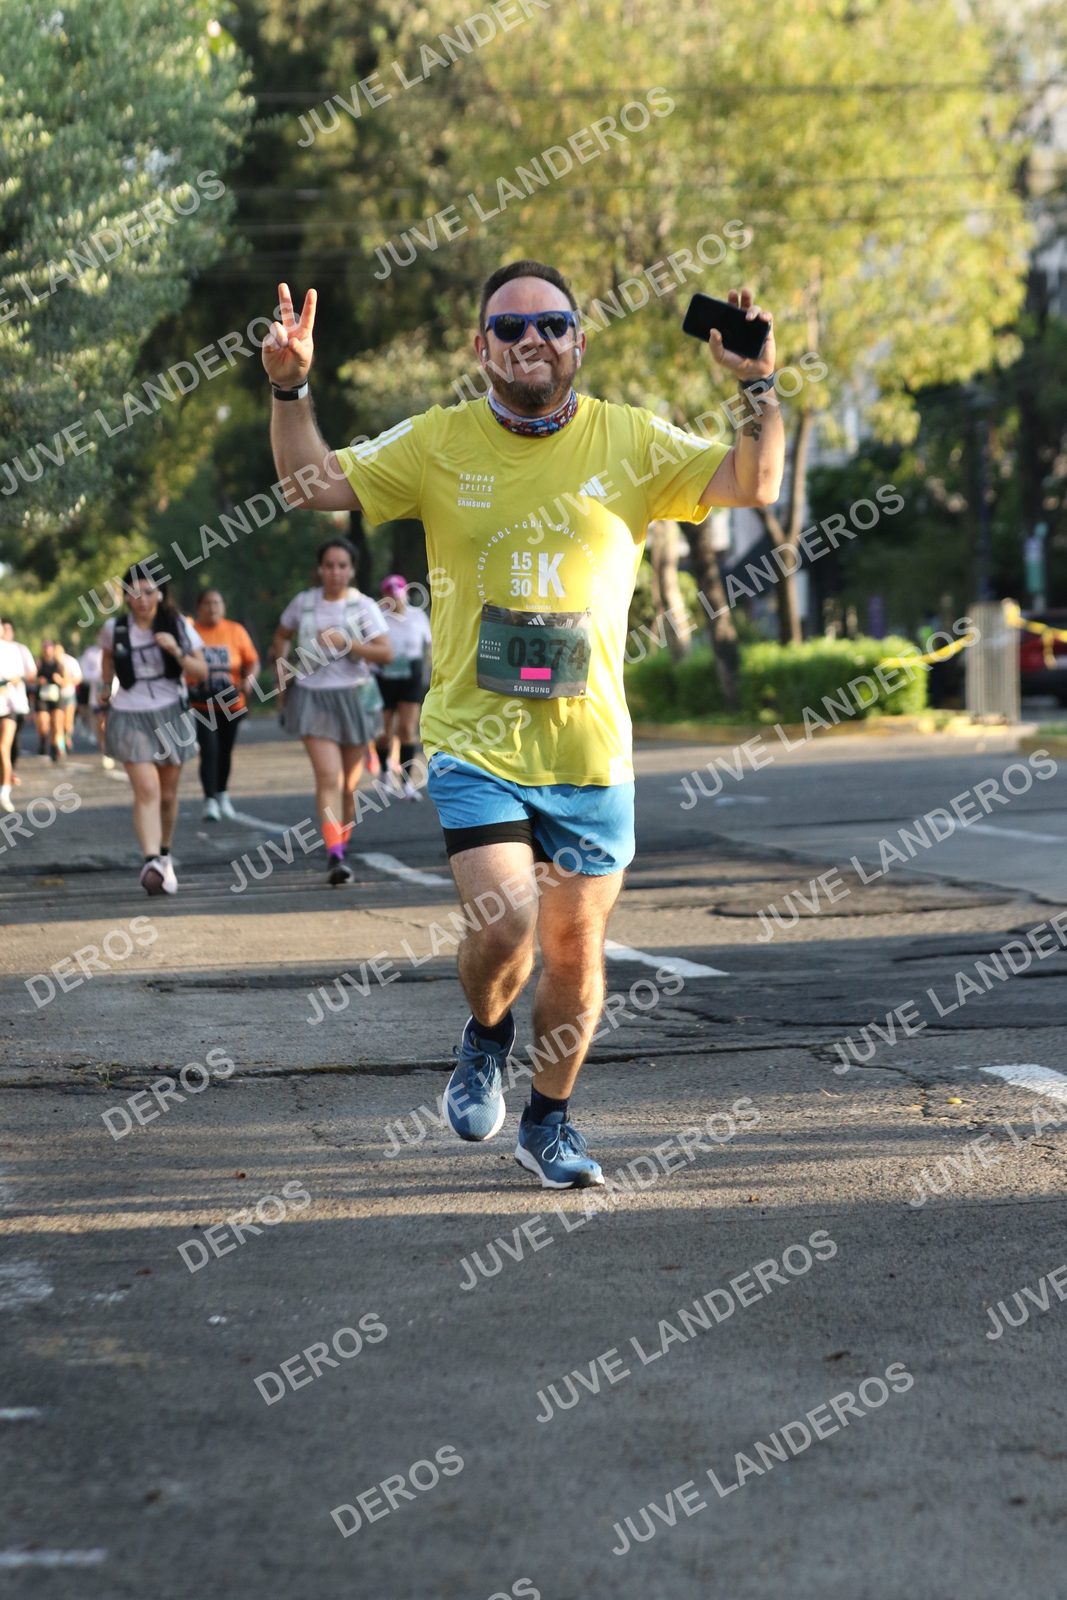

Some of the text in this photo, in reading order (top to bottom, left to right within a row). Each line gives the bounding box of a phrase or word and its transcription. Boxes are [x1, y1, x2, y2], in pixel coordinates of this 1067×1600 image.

[459, 473, 495, 483] ADIDAS
[460, 483, 492, 492] SPLITS
[458, 499, 491, 509] SAMSUNG
[491, 528, 511, 543] GDL
[522, 520, 543, 529] GDL
[511, 551, 532, 570] 15
[538, 552, 566, 598] K
[510, 578, 532, 597] 30
[507, 636, 587, 671] 0374
[513, 684, 551, 694] SAMSUNG
